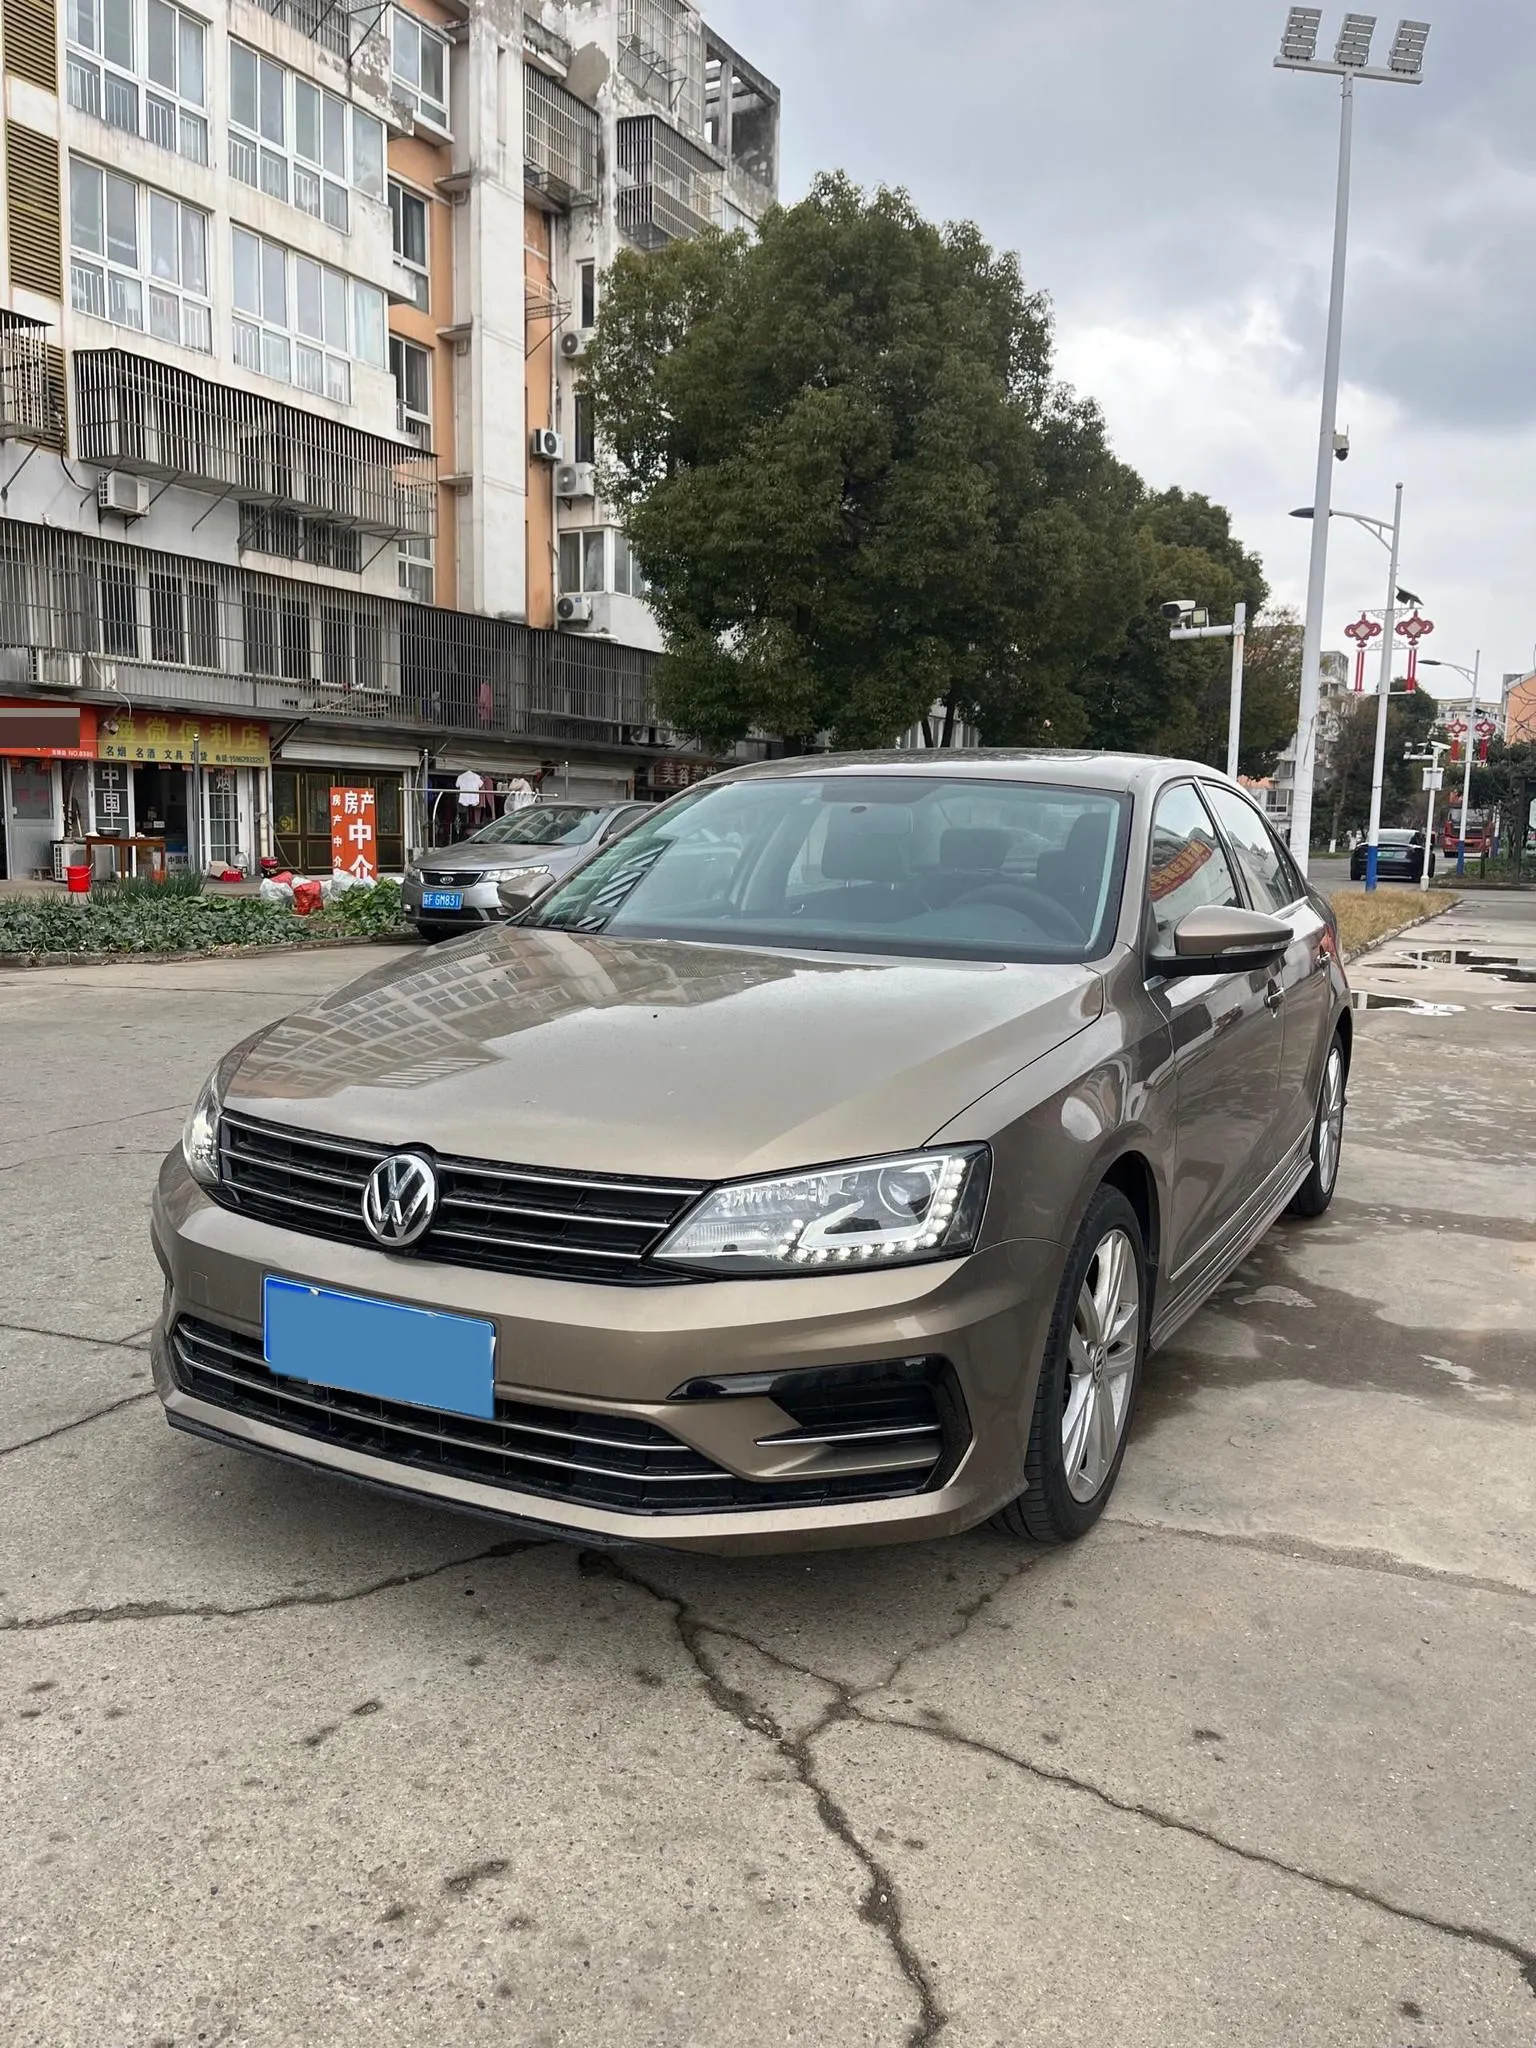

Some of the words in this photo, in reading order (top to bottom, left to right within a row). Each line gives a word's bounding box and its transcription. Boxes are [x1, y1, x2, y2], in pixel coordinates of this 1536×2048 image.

[136, 747, 156, 760] 名酒
[164, 749, 184, 762] 文具
[344, 790, 375, 815] 房产
[348, 818, 374, 880] 中介
